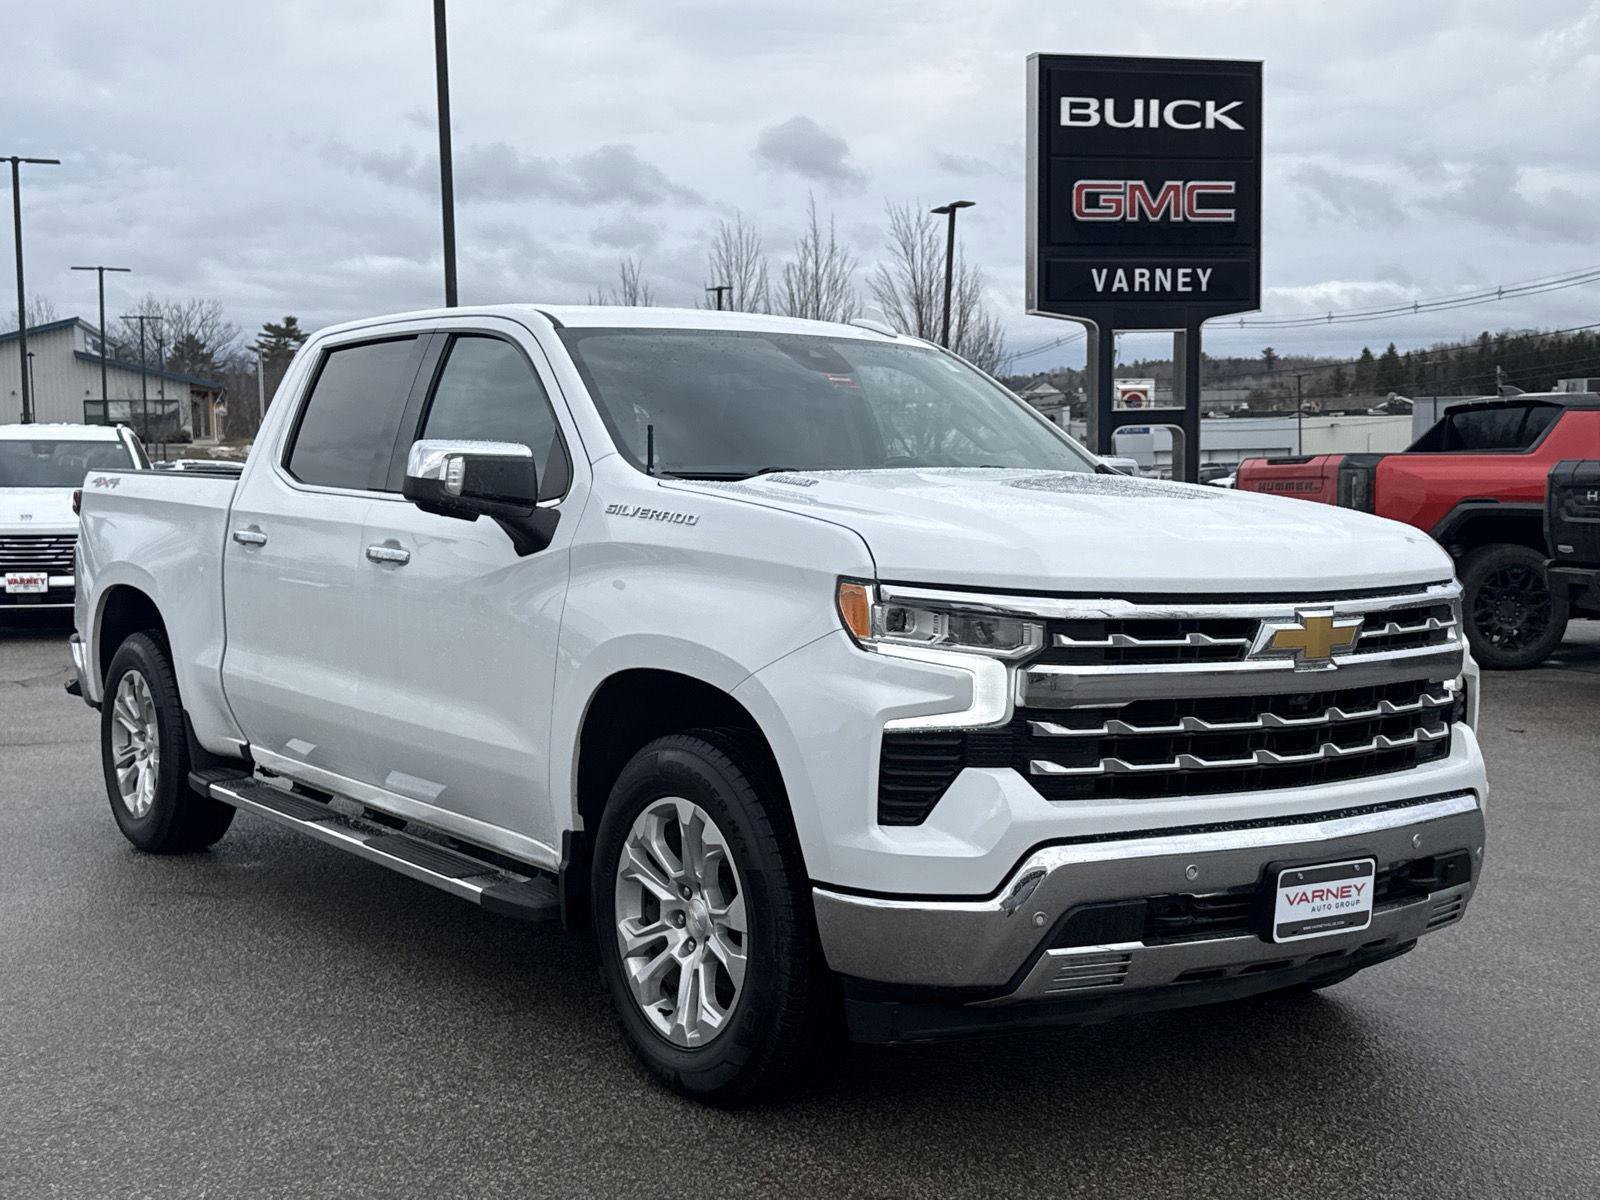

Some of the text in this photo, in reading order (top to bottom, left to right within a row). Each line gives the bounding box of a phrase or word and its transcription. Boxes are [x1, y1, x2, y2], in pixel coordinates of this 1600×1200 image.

[1059, 96, 1245, 131] BUICK
[1072, 179, 1237, 222] GMC
[1090, 267, 1214, 293] VARNEY
[1258, 481, 1314, 492] HUMMER
[605, 503, 700, 526] SILVERADO
[7, 577, 47, 586] VARNEY
[1285, 882, 1367, 906] VARNEY
[1310, 899, 1361, 913] AUTO GROUP
